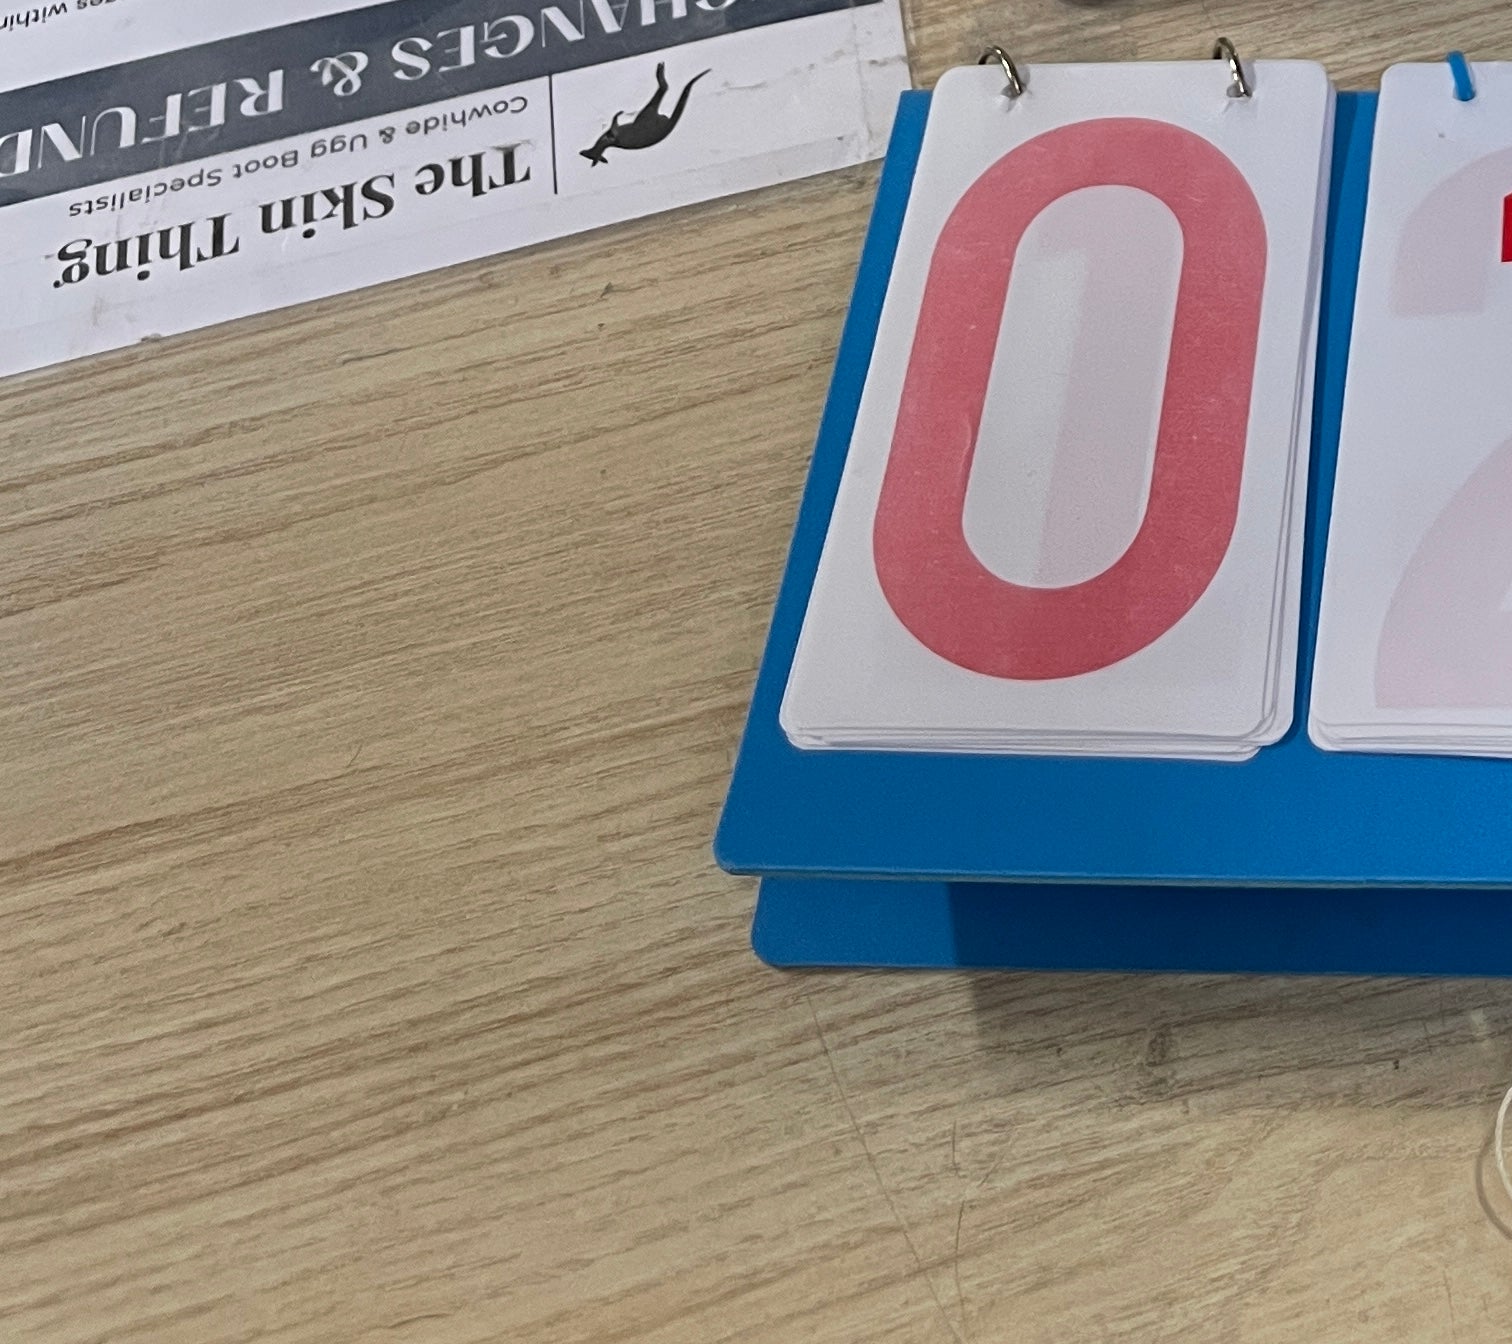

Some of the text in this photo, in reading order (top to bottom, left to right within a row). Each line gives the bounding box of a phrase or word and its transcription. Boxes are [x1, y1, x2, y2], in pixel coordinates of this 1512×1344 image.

[309, 50, 369, 98] &
[51, 144, 531, 291] The Skin Thing
[68, 95, 528, 218] Cowhide & Ugg Boot Specialists
